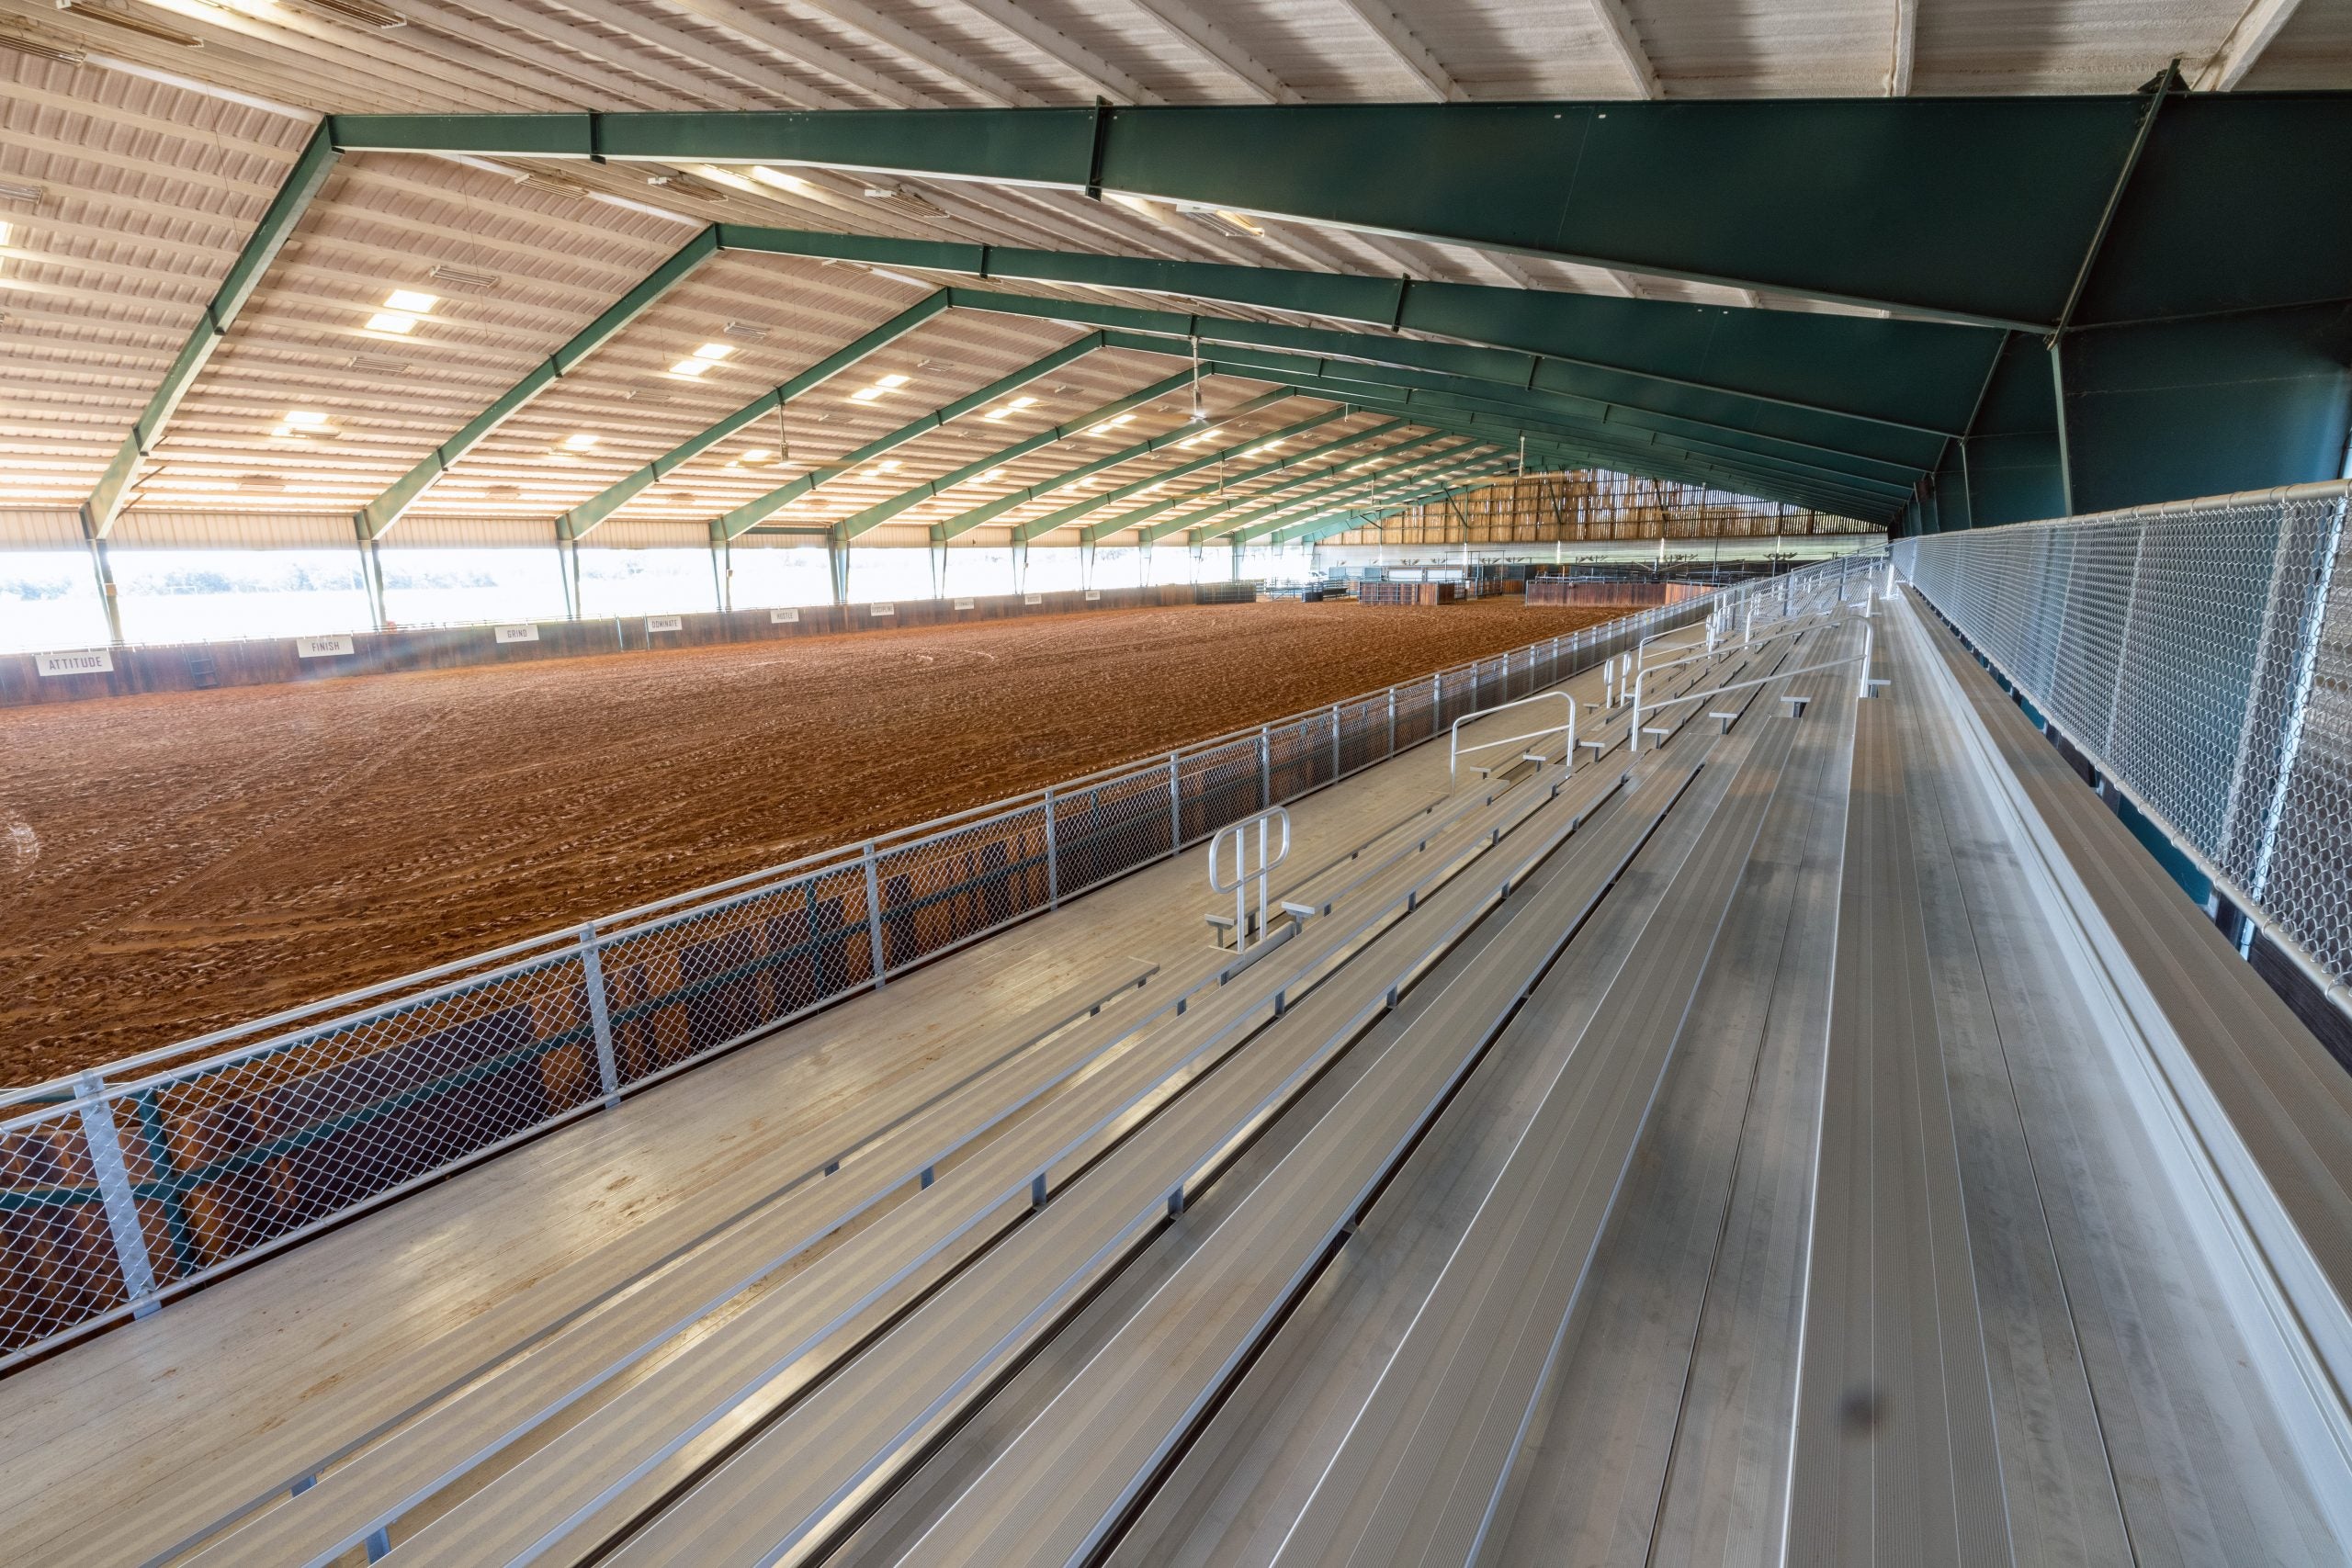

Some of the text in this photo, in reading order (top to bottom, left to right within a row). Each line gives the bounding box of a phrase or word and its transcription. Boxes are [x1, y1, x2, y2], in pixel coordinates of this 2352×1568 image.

[777, 612, 793, 620] HUSTLE
[652, 620, 678, 628] DOMINATE
[507, 629, 527, 638] GRIND
[312, 641, 340, 652] FINISH
[50, 657, 102, 670] ATTITUDE
